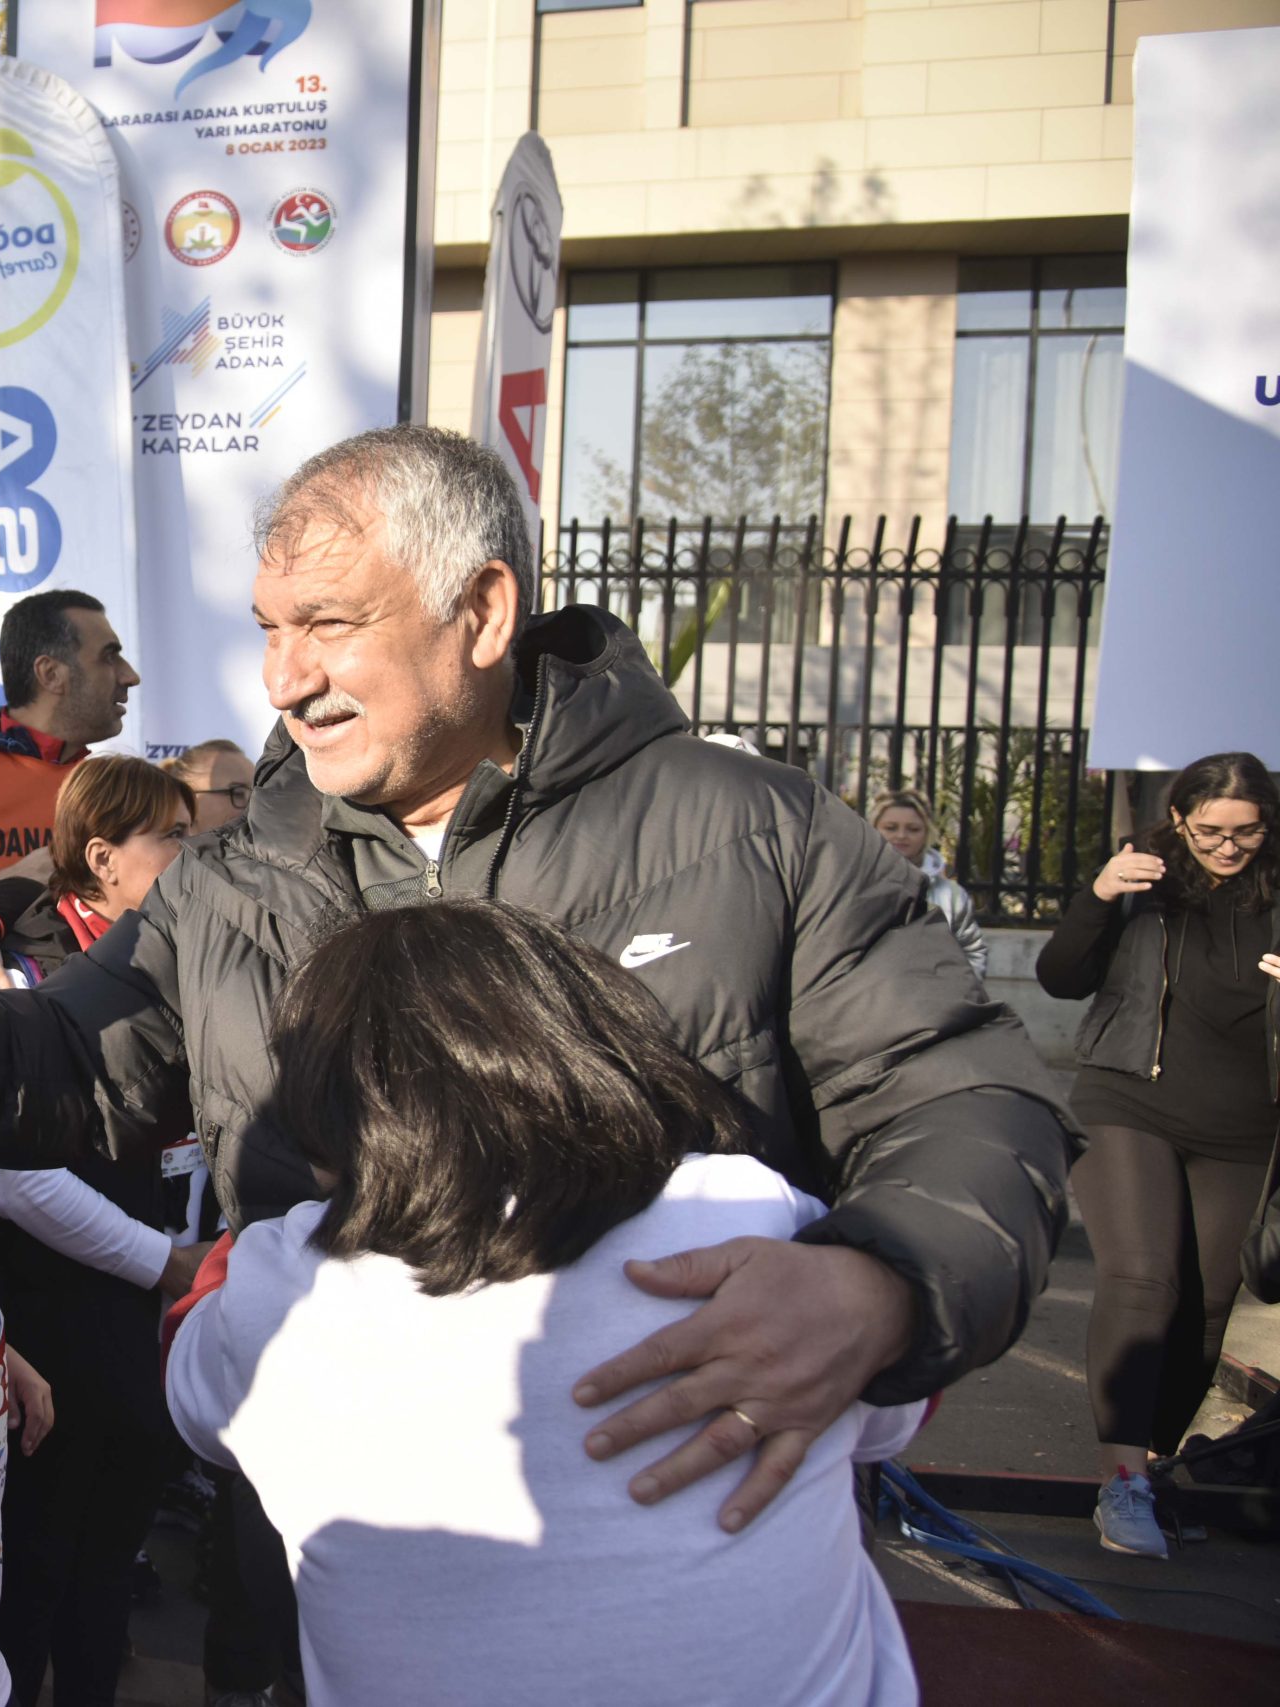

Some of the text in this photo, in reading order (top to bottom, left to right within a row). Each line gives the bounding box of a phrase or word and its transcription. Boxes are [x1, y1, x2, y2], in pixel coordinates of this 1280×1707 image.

[295, 75, 328, 93] 13.
[100, 99, 328, 128] LARARASI ADANA KURTULUŞ
[195, 118, 328, 139] YARI MARATONU
[225, 138, 328, 156] 8 OCAK 2023
[217, 313, 285, 330] BÜYÜK
[224, 332, 284, 354] ŞEHİR
[215, 356, 284, 370] ADANA
[142, 412, 242, 432] ZEYDAN
[142, 435, 260, 455] KARALAR
